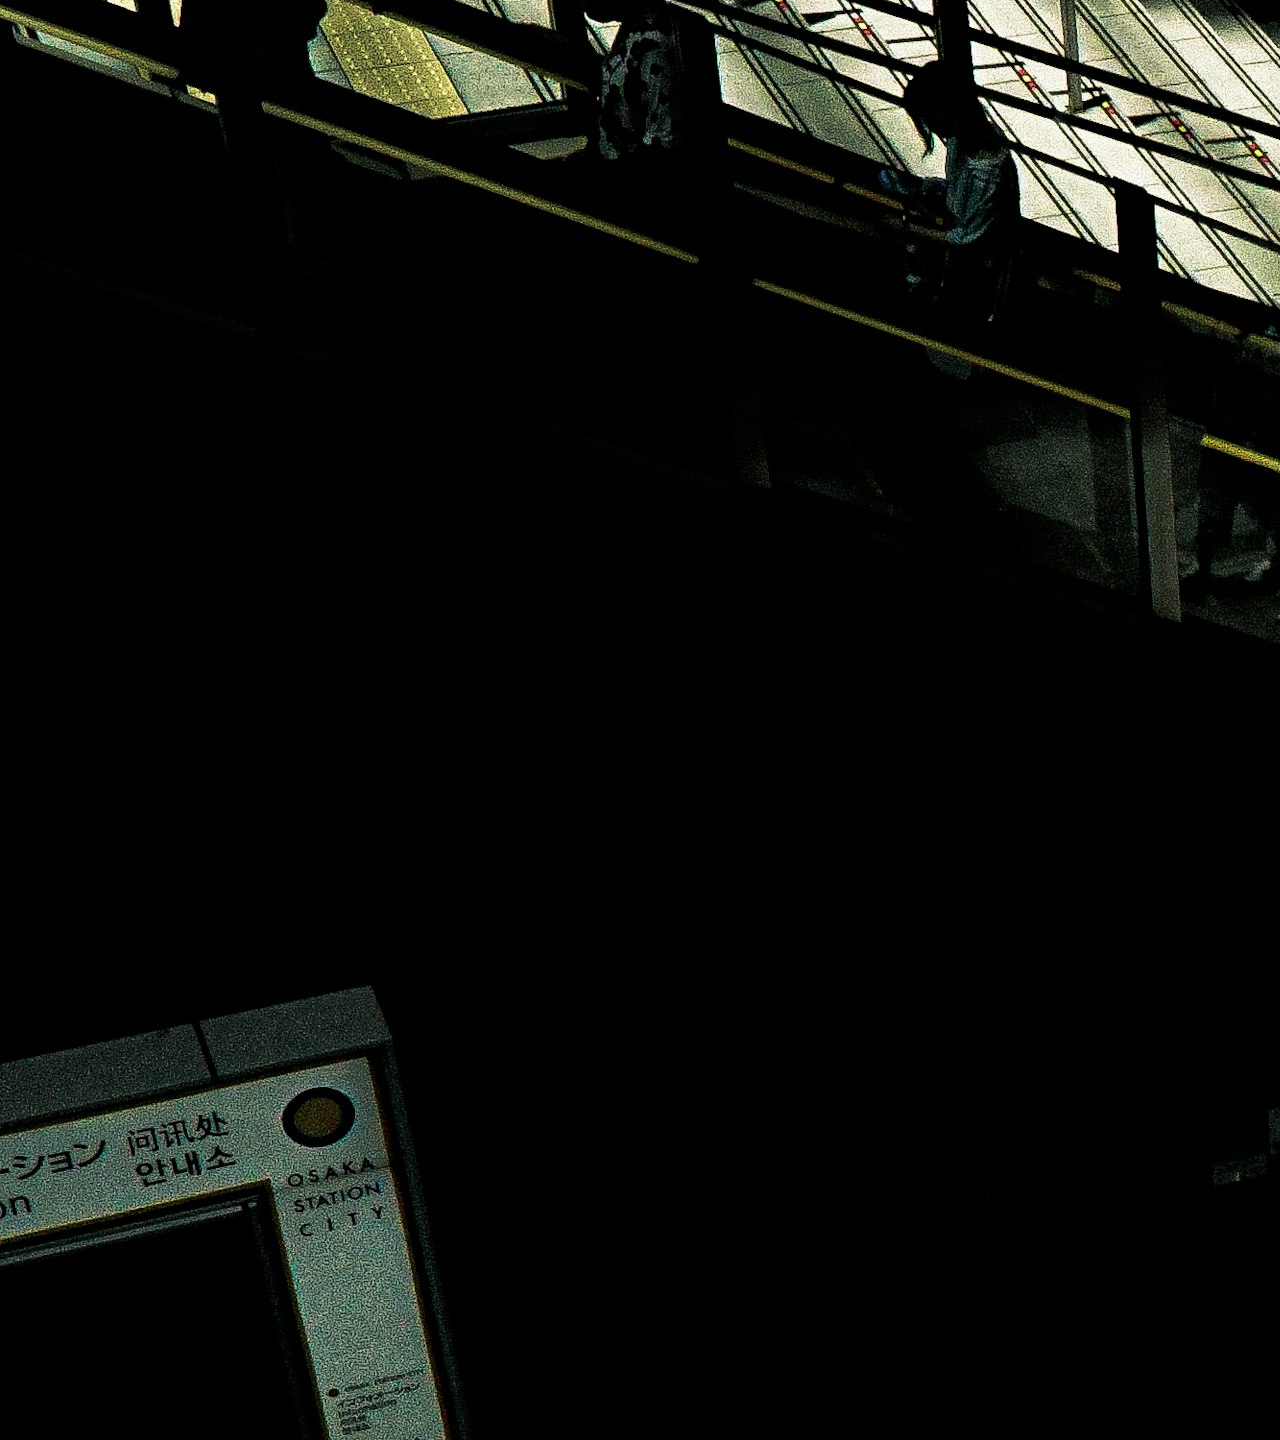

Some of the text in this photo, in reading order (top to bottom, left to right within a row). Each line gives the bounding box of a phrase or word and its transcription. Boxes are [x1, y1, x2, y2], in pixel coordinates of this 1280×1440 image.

[128, 1111, 229, 1157] 问讯处
[136, 1145, 238, 1188] 안내소
[288, 1157, 375, 1187] OSAKA
[293, 1182, 381, 1213] STATION
[299, 1206, 383, 1237] CITY
